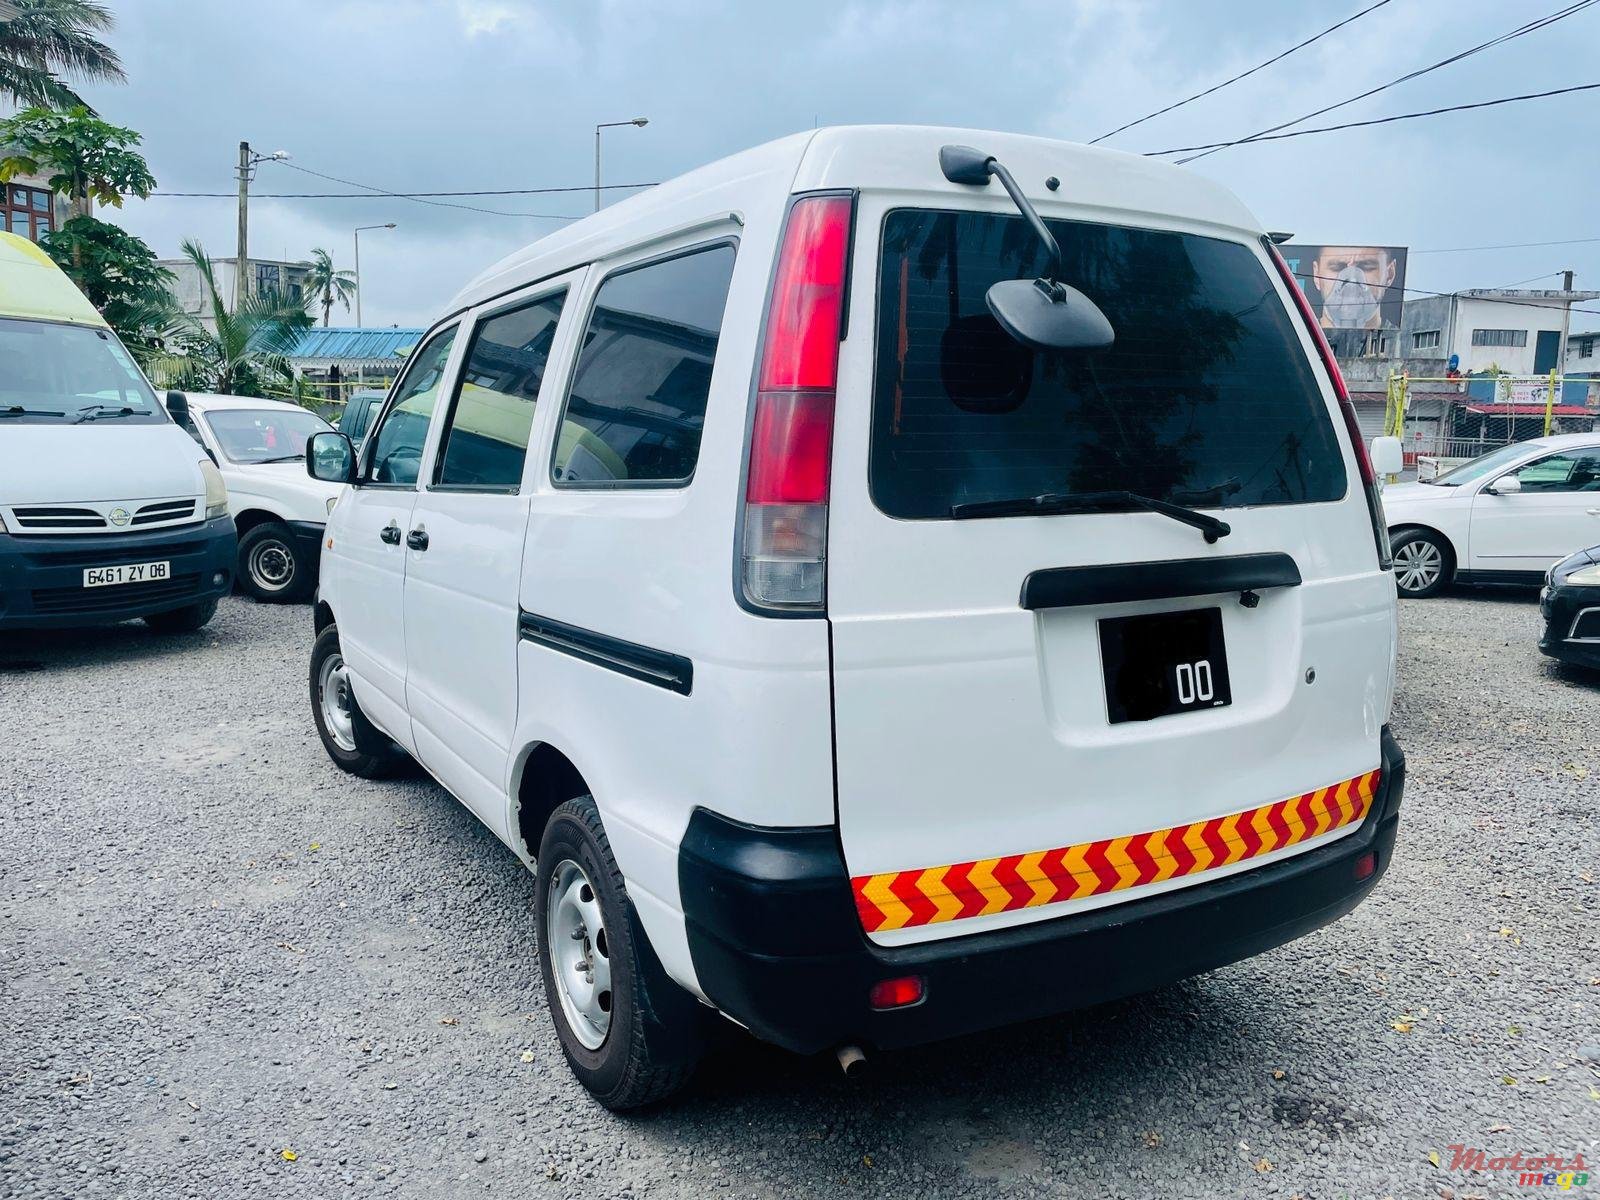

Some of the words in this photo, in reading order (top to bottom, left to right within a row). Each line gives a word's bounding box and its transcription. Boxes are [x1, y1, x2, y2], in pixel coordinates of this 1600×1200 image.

[88, 568, 122, 585] 6461
[129, 566, 144, 581] ZY
[150, 563, 166, 578] 08
